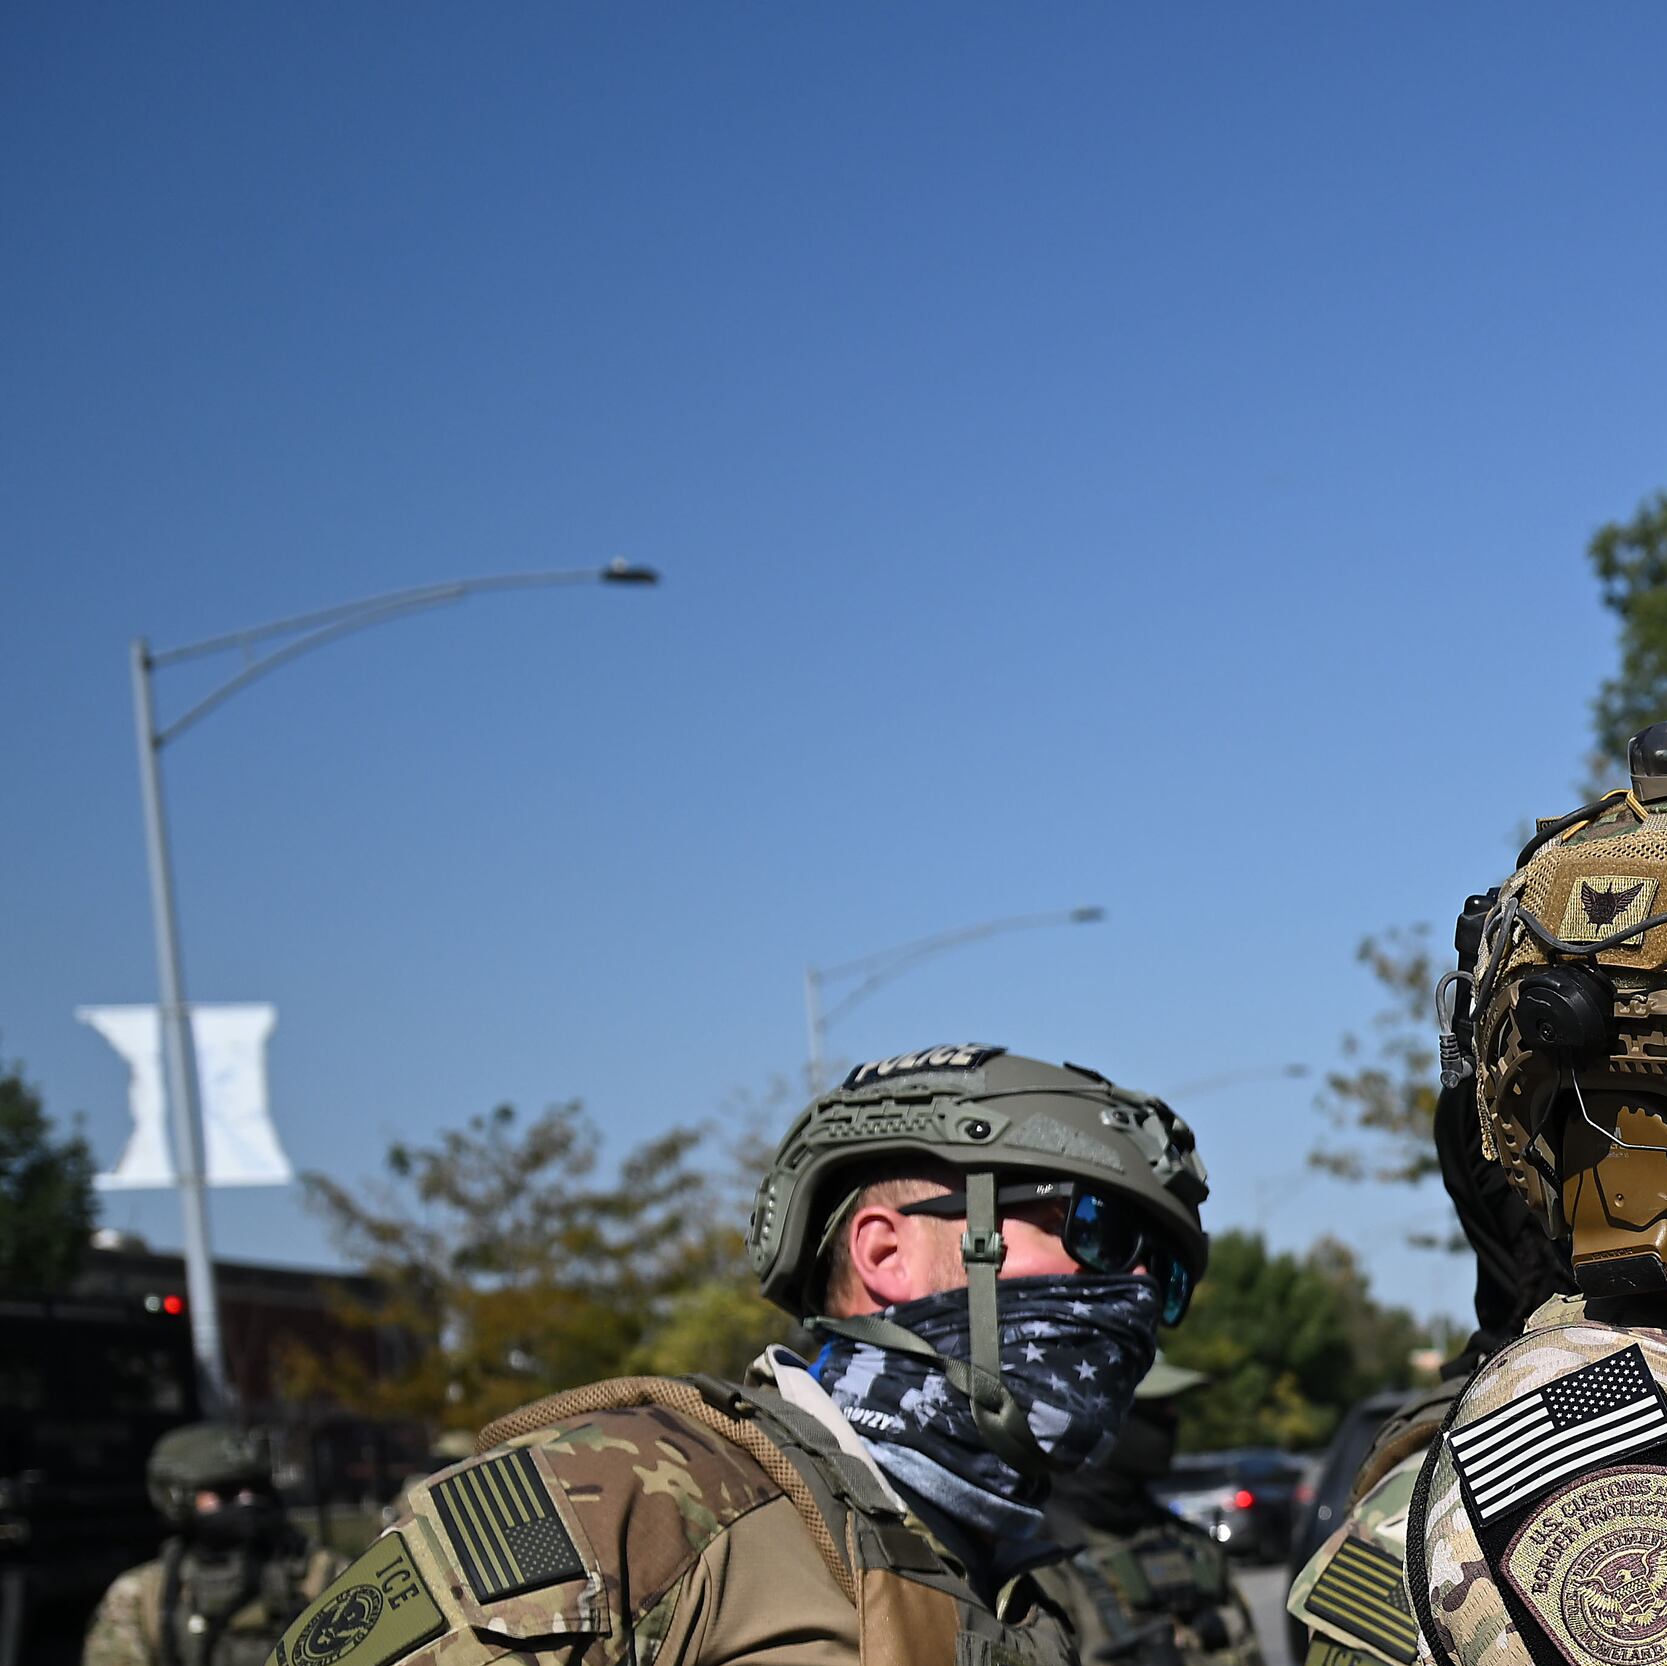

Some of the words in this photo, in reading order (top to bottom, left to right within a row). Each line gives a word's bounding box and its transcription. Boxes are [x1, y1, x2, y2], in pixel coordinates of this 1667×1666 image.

[1530, 1516, 1564, 1545] U.S.
[1561, 1479, 1651, 1518] CUSTOMS
[375, 1556, 421, 1611] ICE
[1532, 1526, 1580, 1594] BORDER
[1580, 1631, 1666, 1661] HOMELAND
